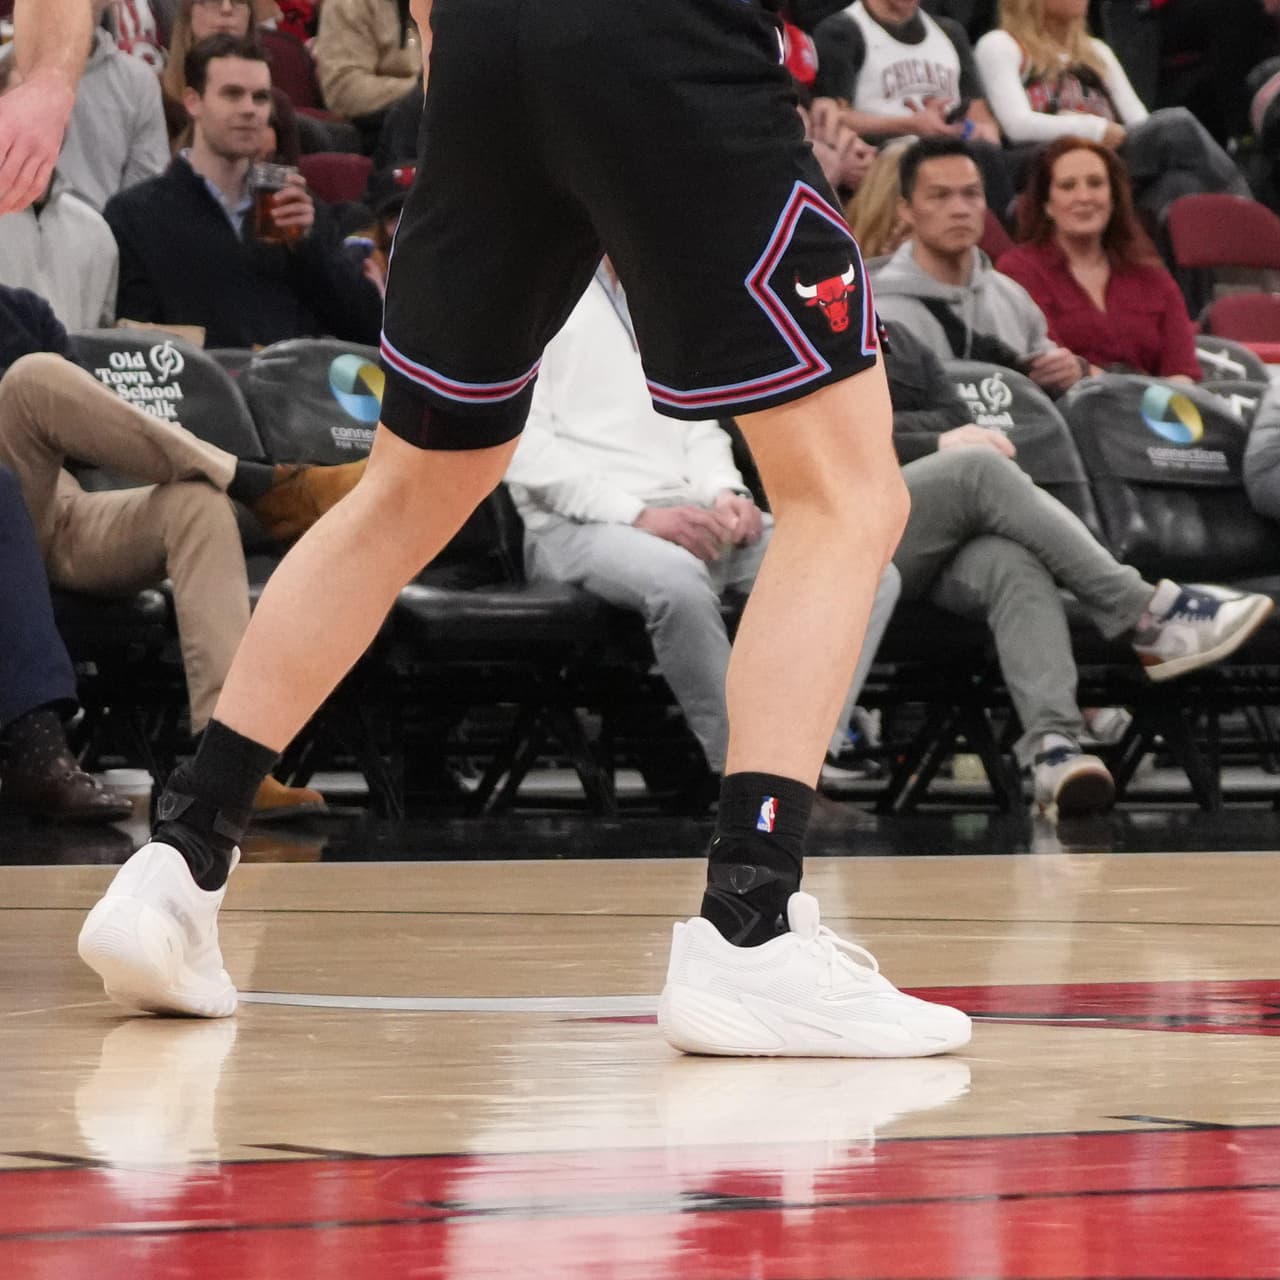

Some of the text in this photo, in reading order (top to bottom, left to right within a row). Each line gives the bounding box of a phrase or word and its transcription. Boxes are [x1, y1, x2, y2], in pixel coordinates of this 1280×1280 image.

[109, 351, 146, 370] Old
[95, 368, 154, 385] Town
[116, 381, 184, 401] School
